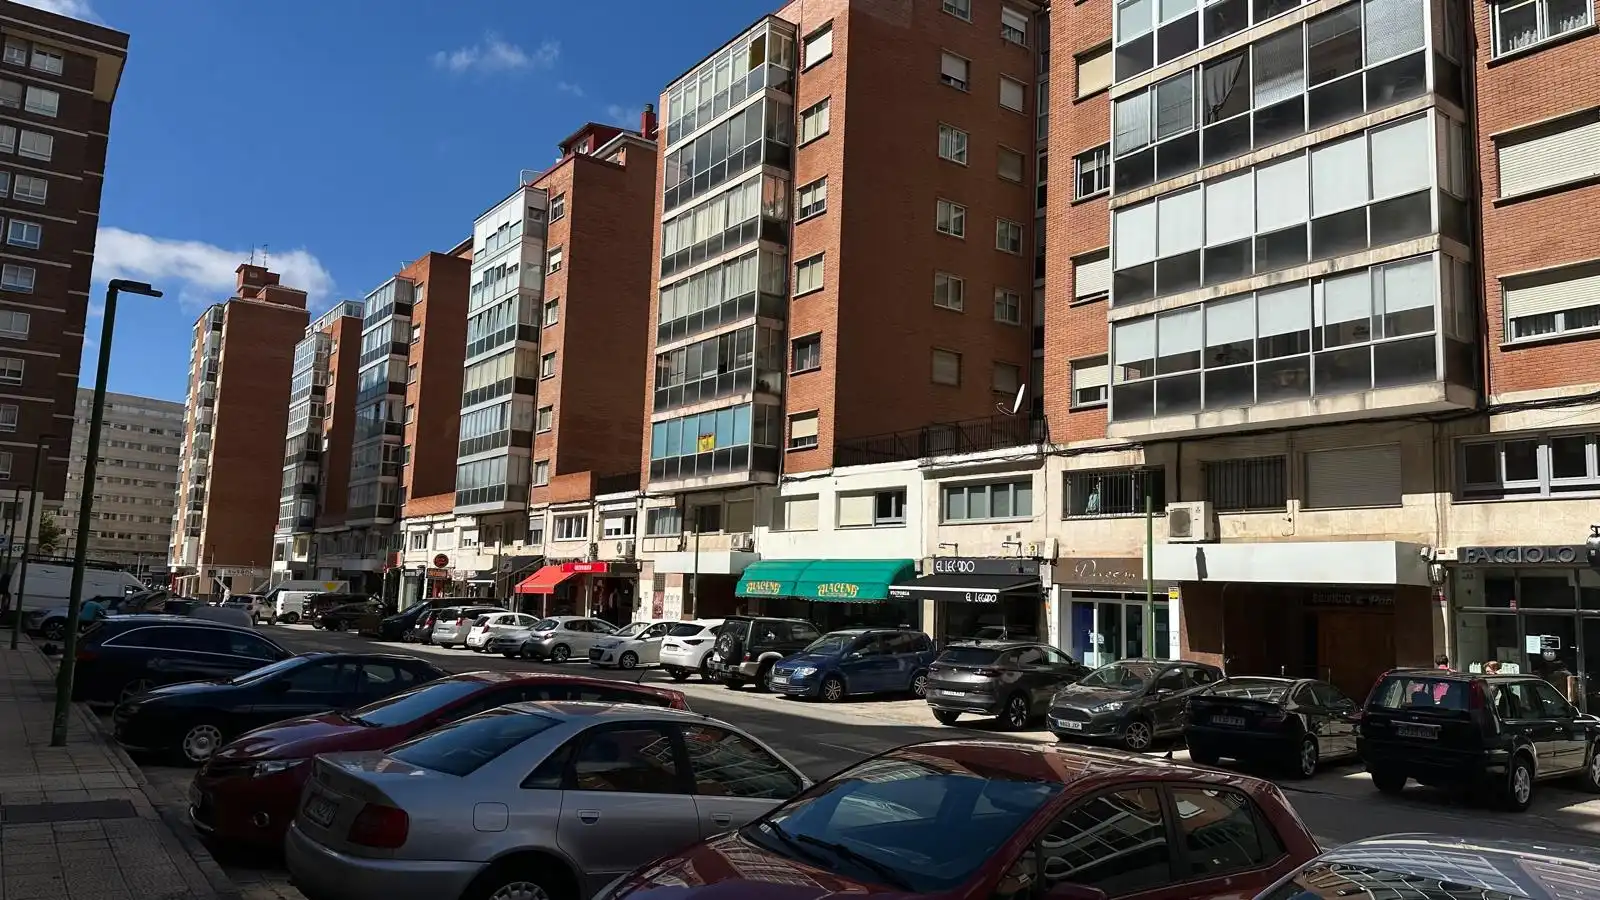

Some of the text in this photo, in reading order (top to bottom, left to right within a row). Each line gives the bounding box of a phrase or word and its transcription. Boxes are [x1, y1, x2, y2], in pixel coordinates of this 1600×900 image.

[1465, 546, 1576, 563] FACCIOLO
[936, 560, 944, 572] EL
[817, 582, 859, 598] ALACENA
[965, 592, 971, 602] EL
